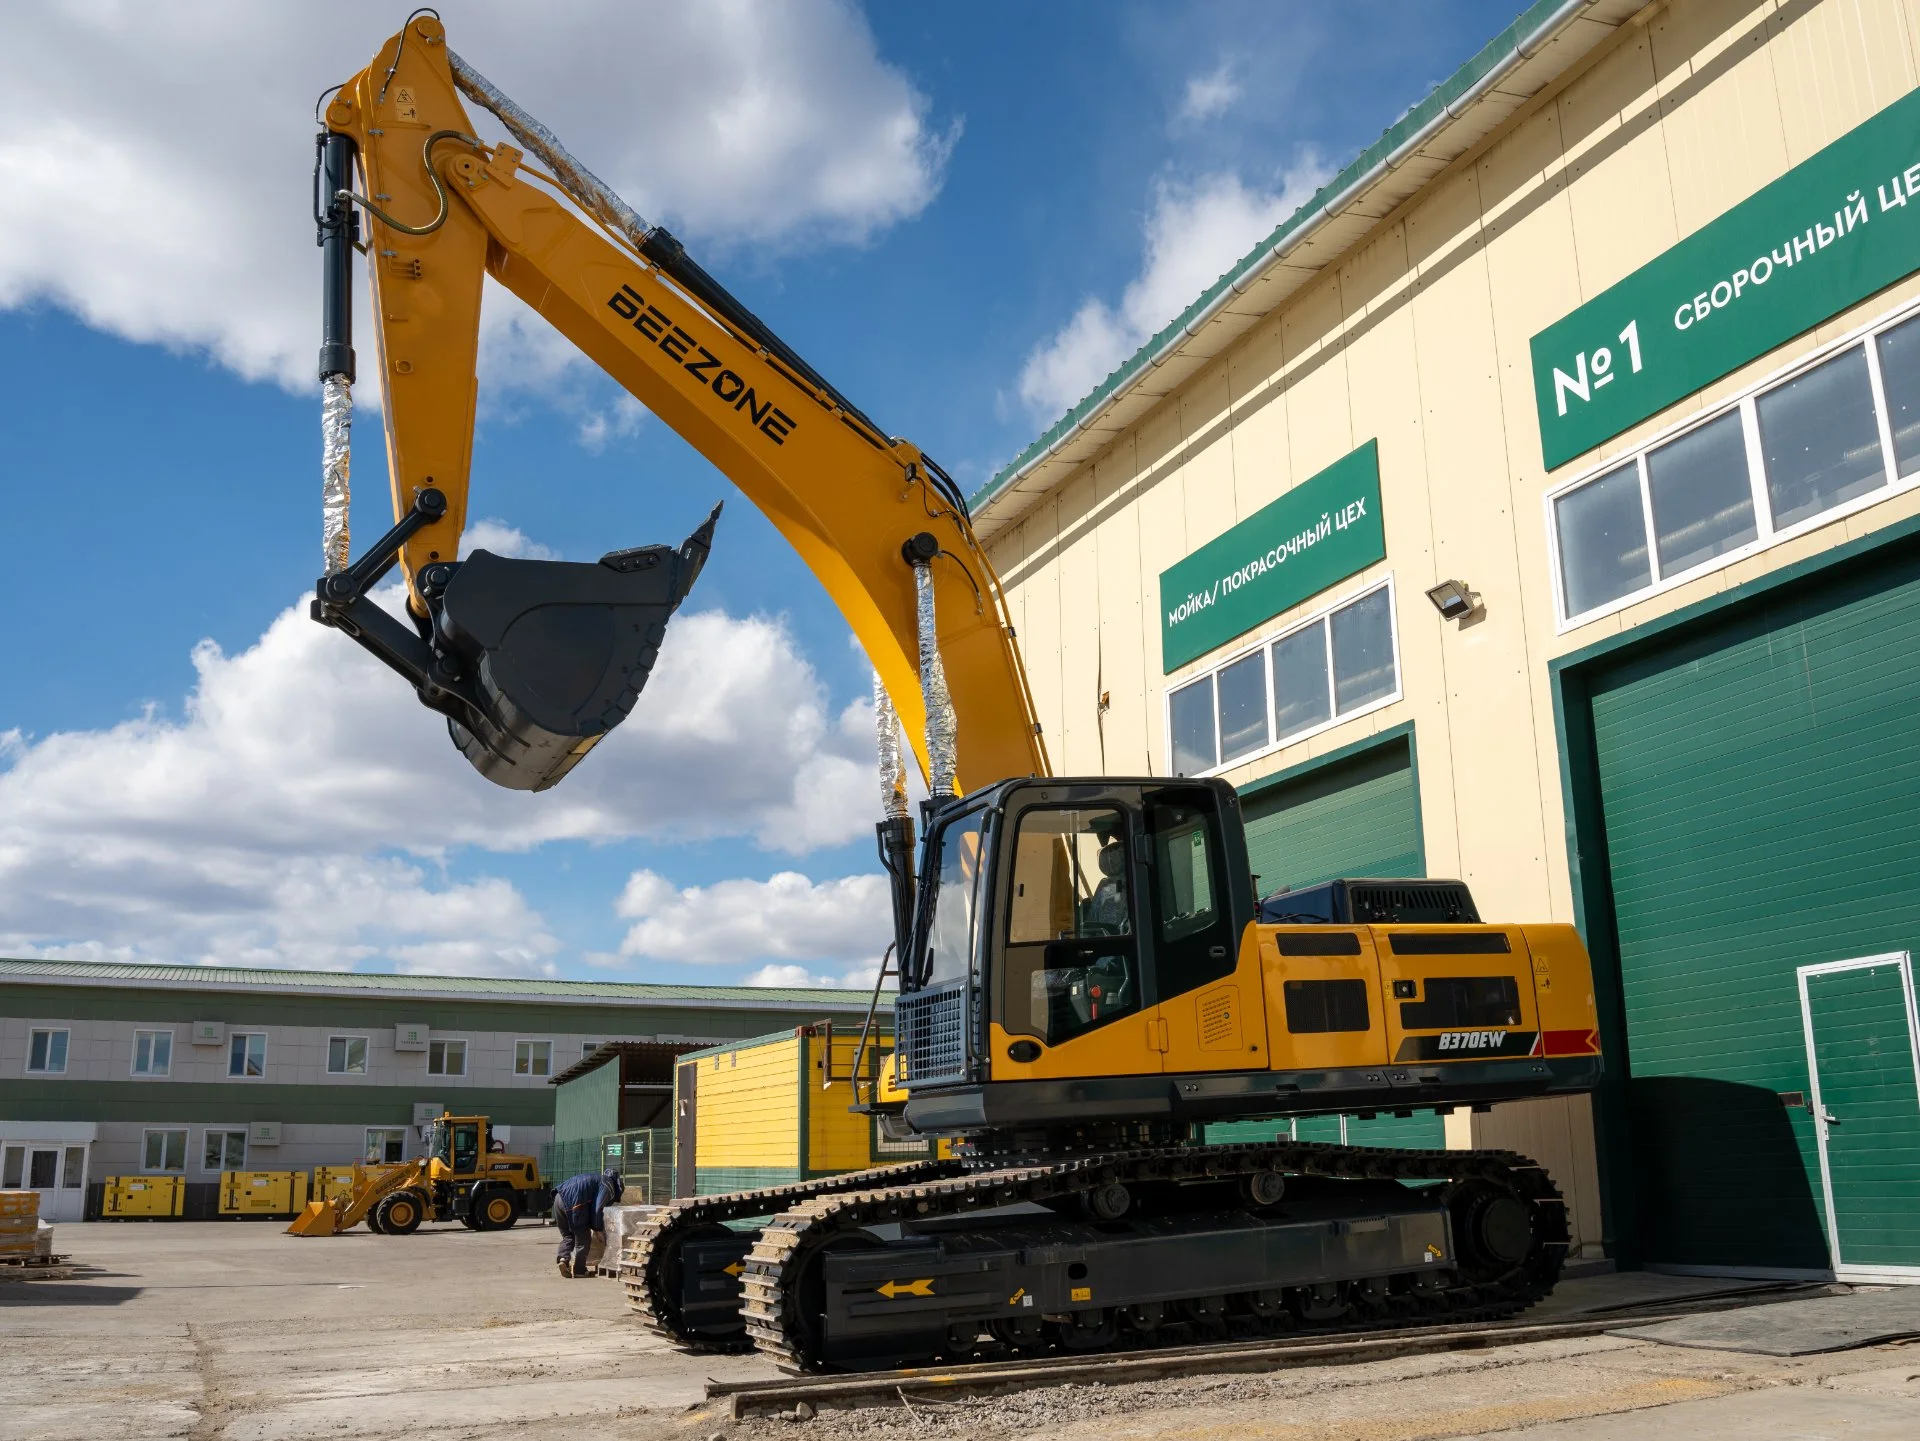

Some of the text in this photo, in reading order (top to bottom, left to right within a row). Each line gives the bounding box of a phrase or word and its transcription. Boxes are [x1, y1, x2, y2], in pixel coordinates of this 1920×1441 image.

[1674, 190, 1869, 330] СБОРОЧНЫЙ
[607, 284, 797, 446] BEEZONE
[1168, 497, 1367, 627] МОЙКА/ ПОКРАСОЧНЫЙ ЦЕХ
[1438, 1030, 1507, 1050] B370EW
